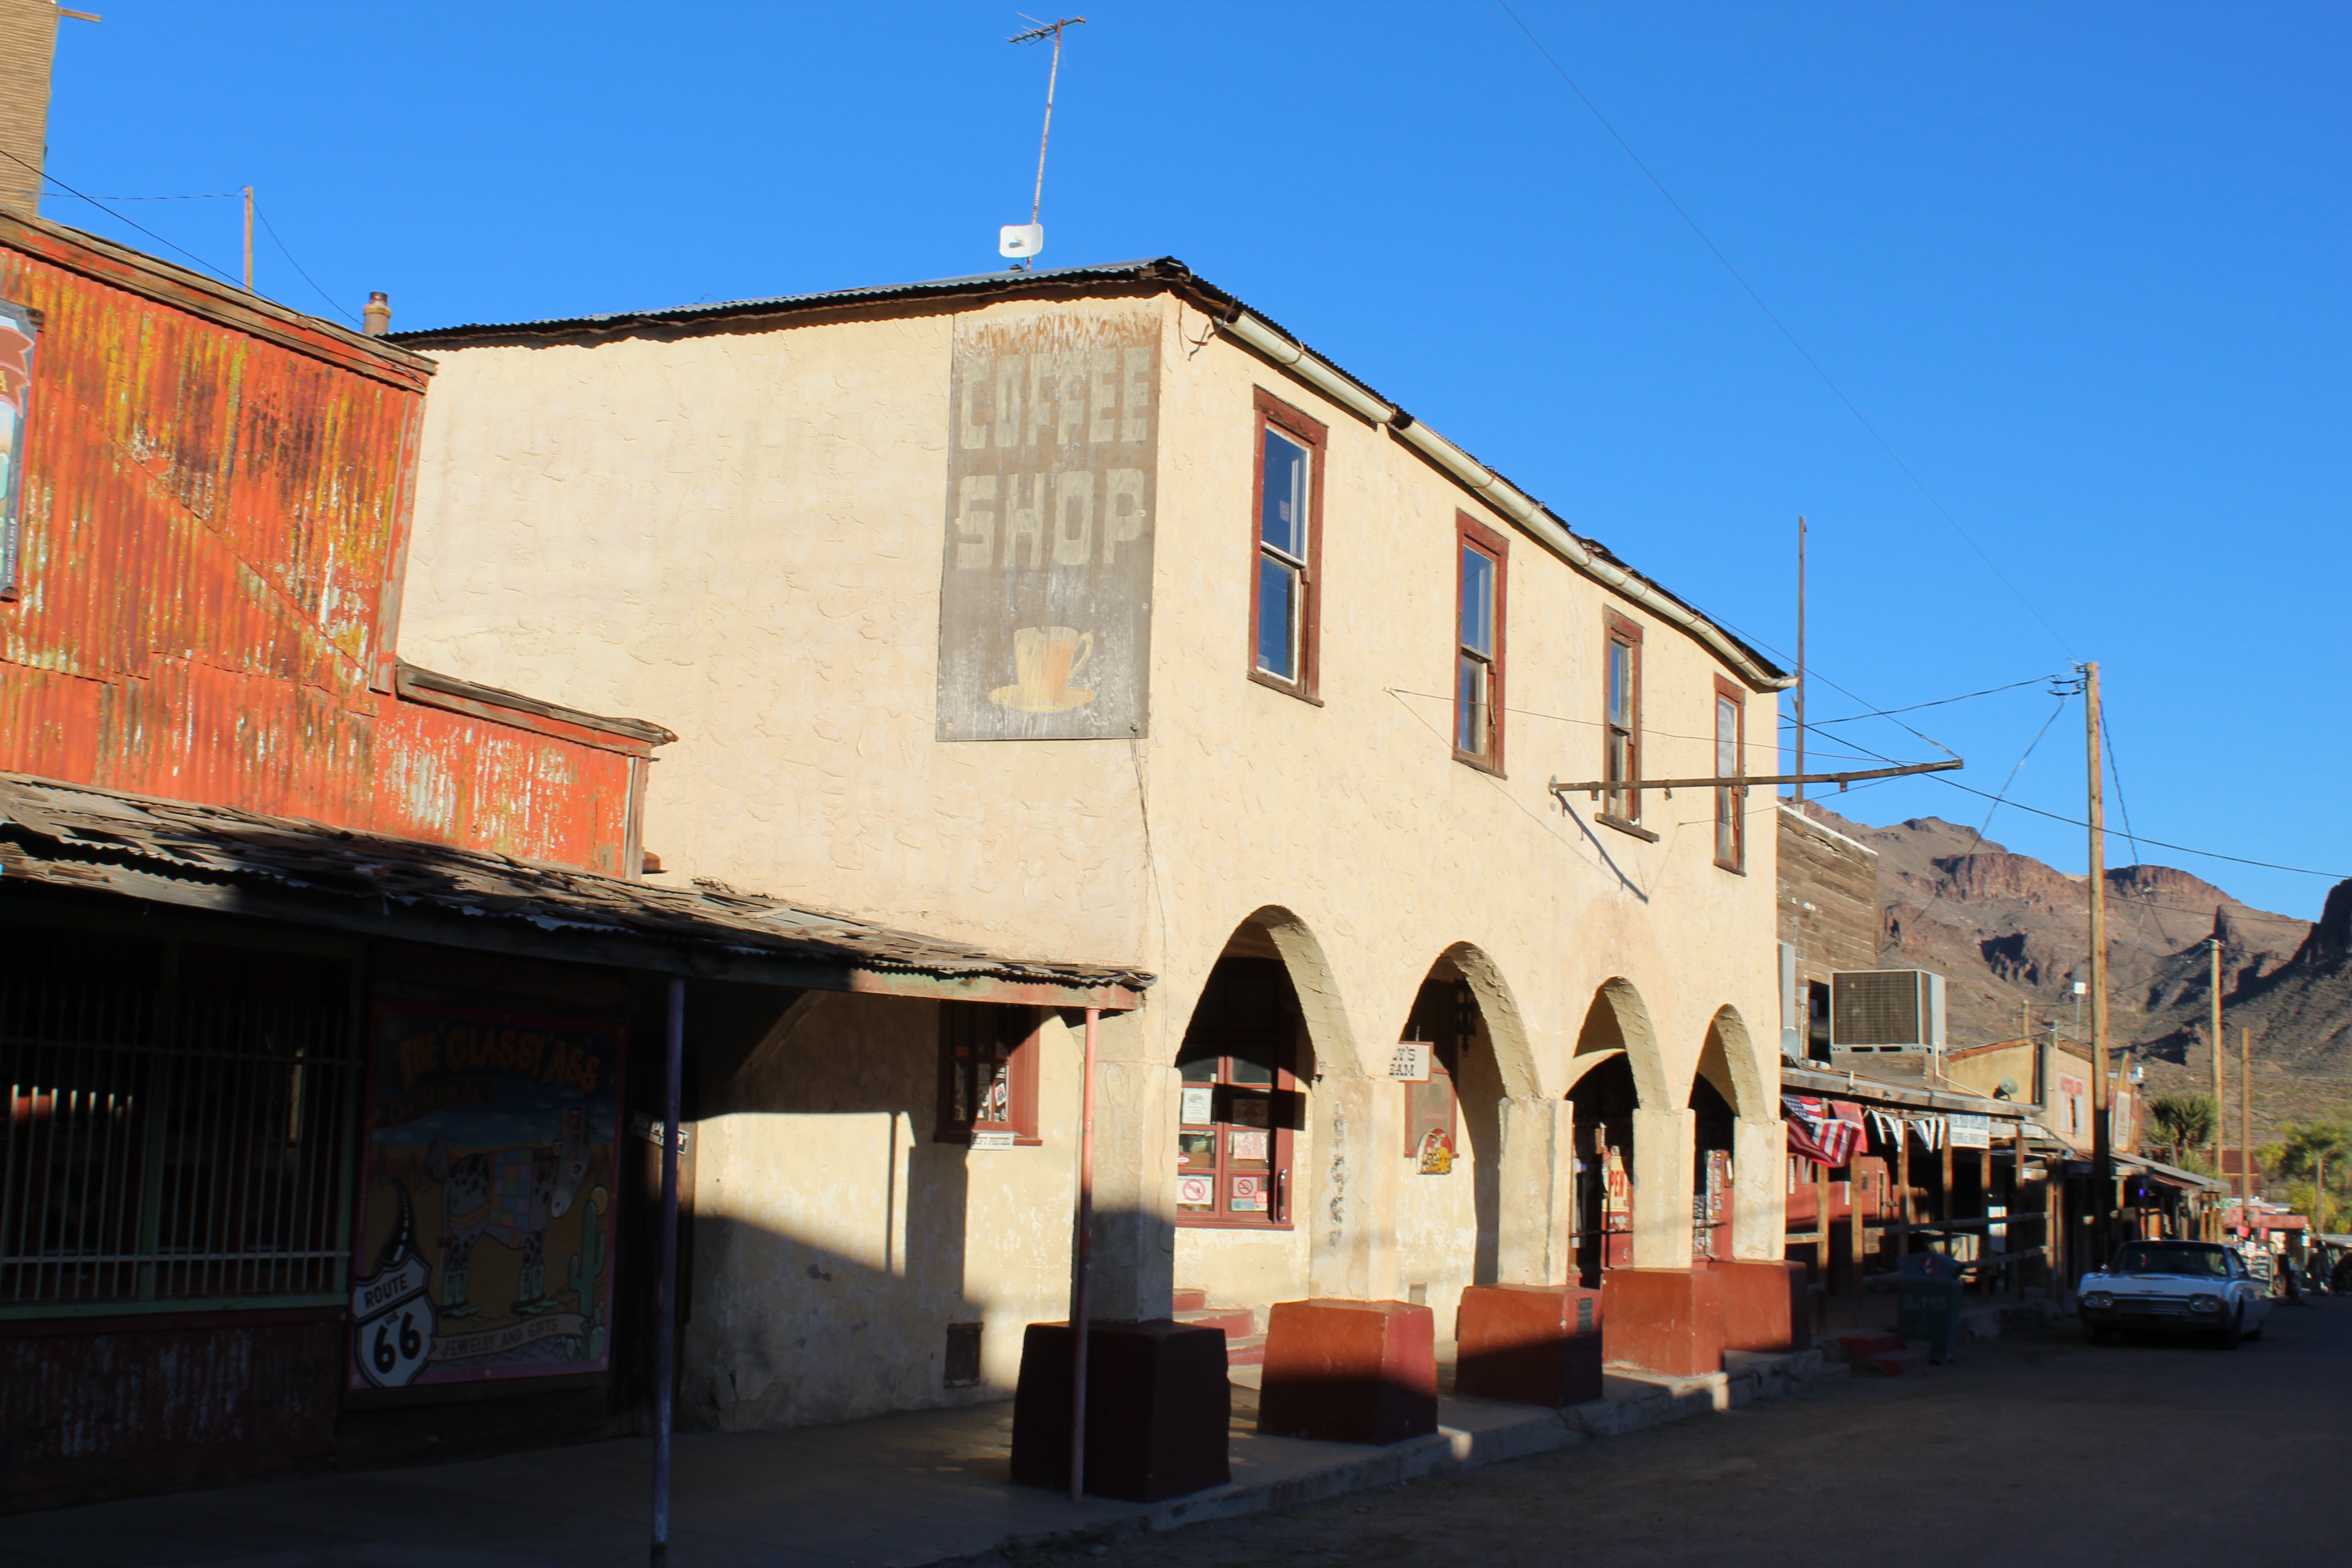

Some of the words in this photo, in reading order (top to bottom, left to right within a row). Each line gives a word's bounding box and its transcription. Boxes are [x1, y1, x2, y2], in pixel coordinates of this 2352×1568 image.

[960, 348, 1150, 450] COFFEE
[956, 468, 1145, 570] SHOP
[397, 1033, 440, 1088] THE
[446, 1026, 547, 1078] CLASSY
[541, 1040, 600, 1092] ASS
[365, 1272, 408, 1308] ROUTE
[374, 1312, 421, 1374] 66
[441, 1334, 495, 1358] JEWELRY
[500, 1329, 523, 1348] AND
[528, 1318, 558, 1337] GIFTS
